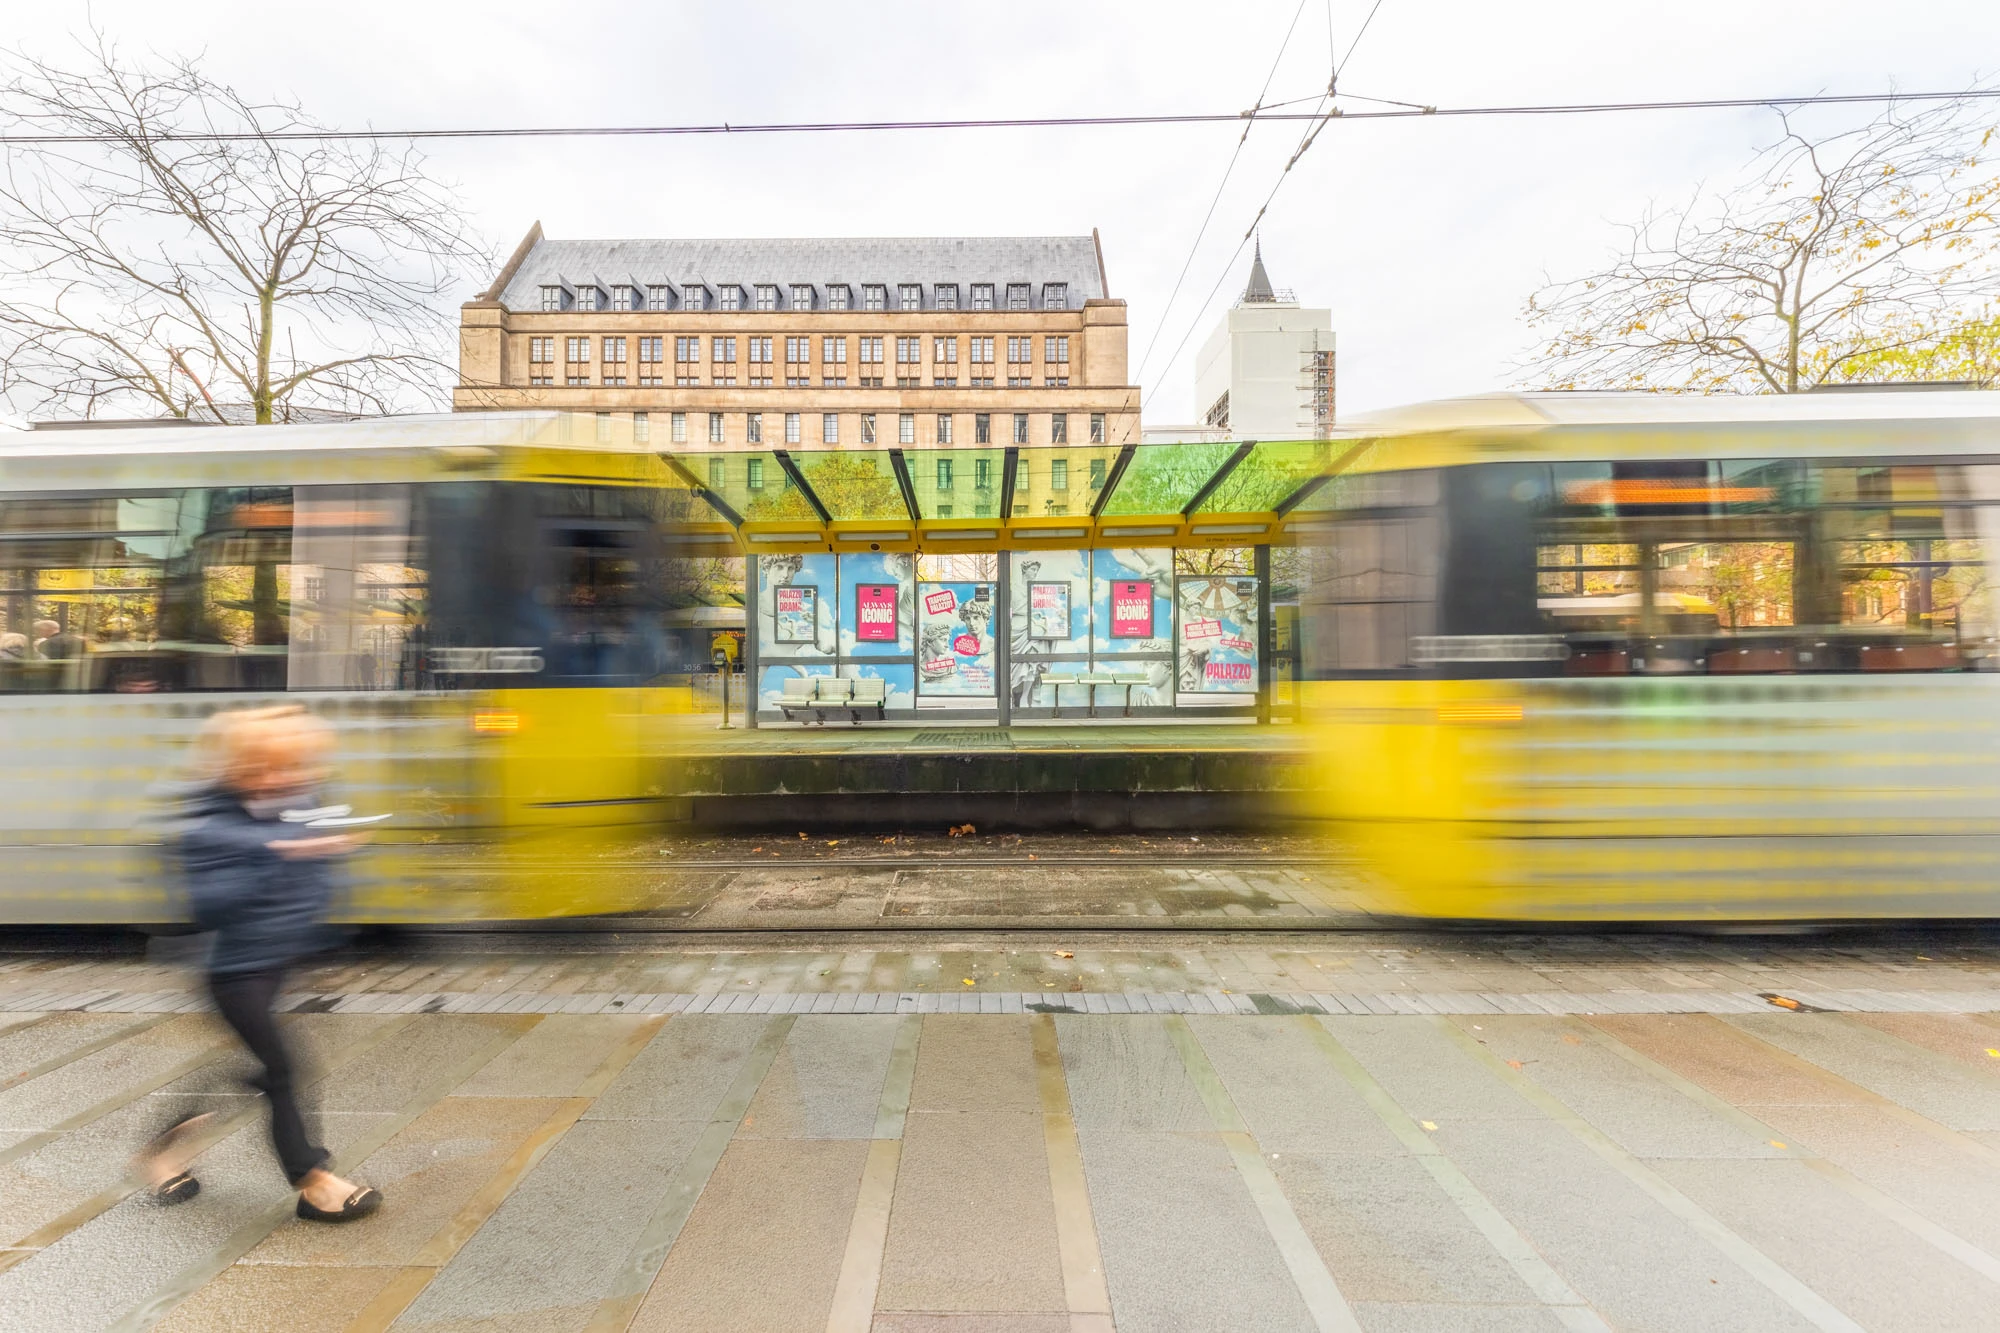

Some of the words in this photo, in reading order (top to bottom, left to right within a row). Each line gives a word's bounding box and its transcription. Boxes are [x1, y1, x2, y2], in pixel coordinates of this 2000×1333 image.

[861, 608, 893, 624] ICONIC
[1116, 605, 1149, 621] ICONIC
[683, 663, 702, 672] 3056
[1206, 662, 1252, 680] PALAZZO
